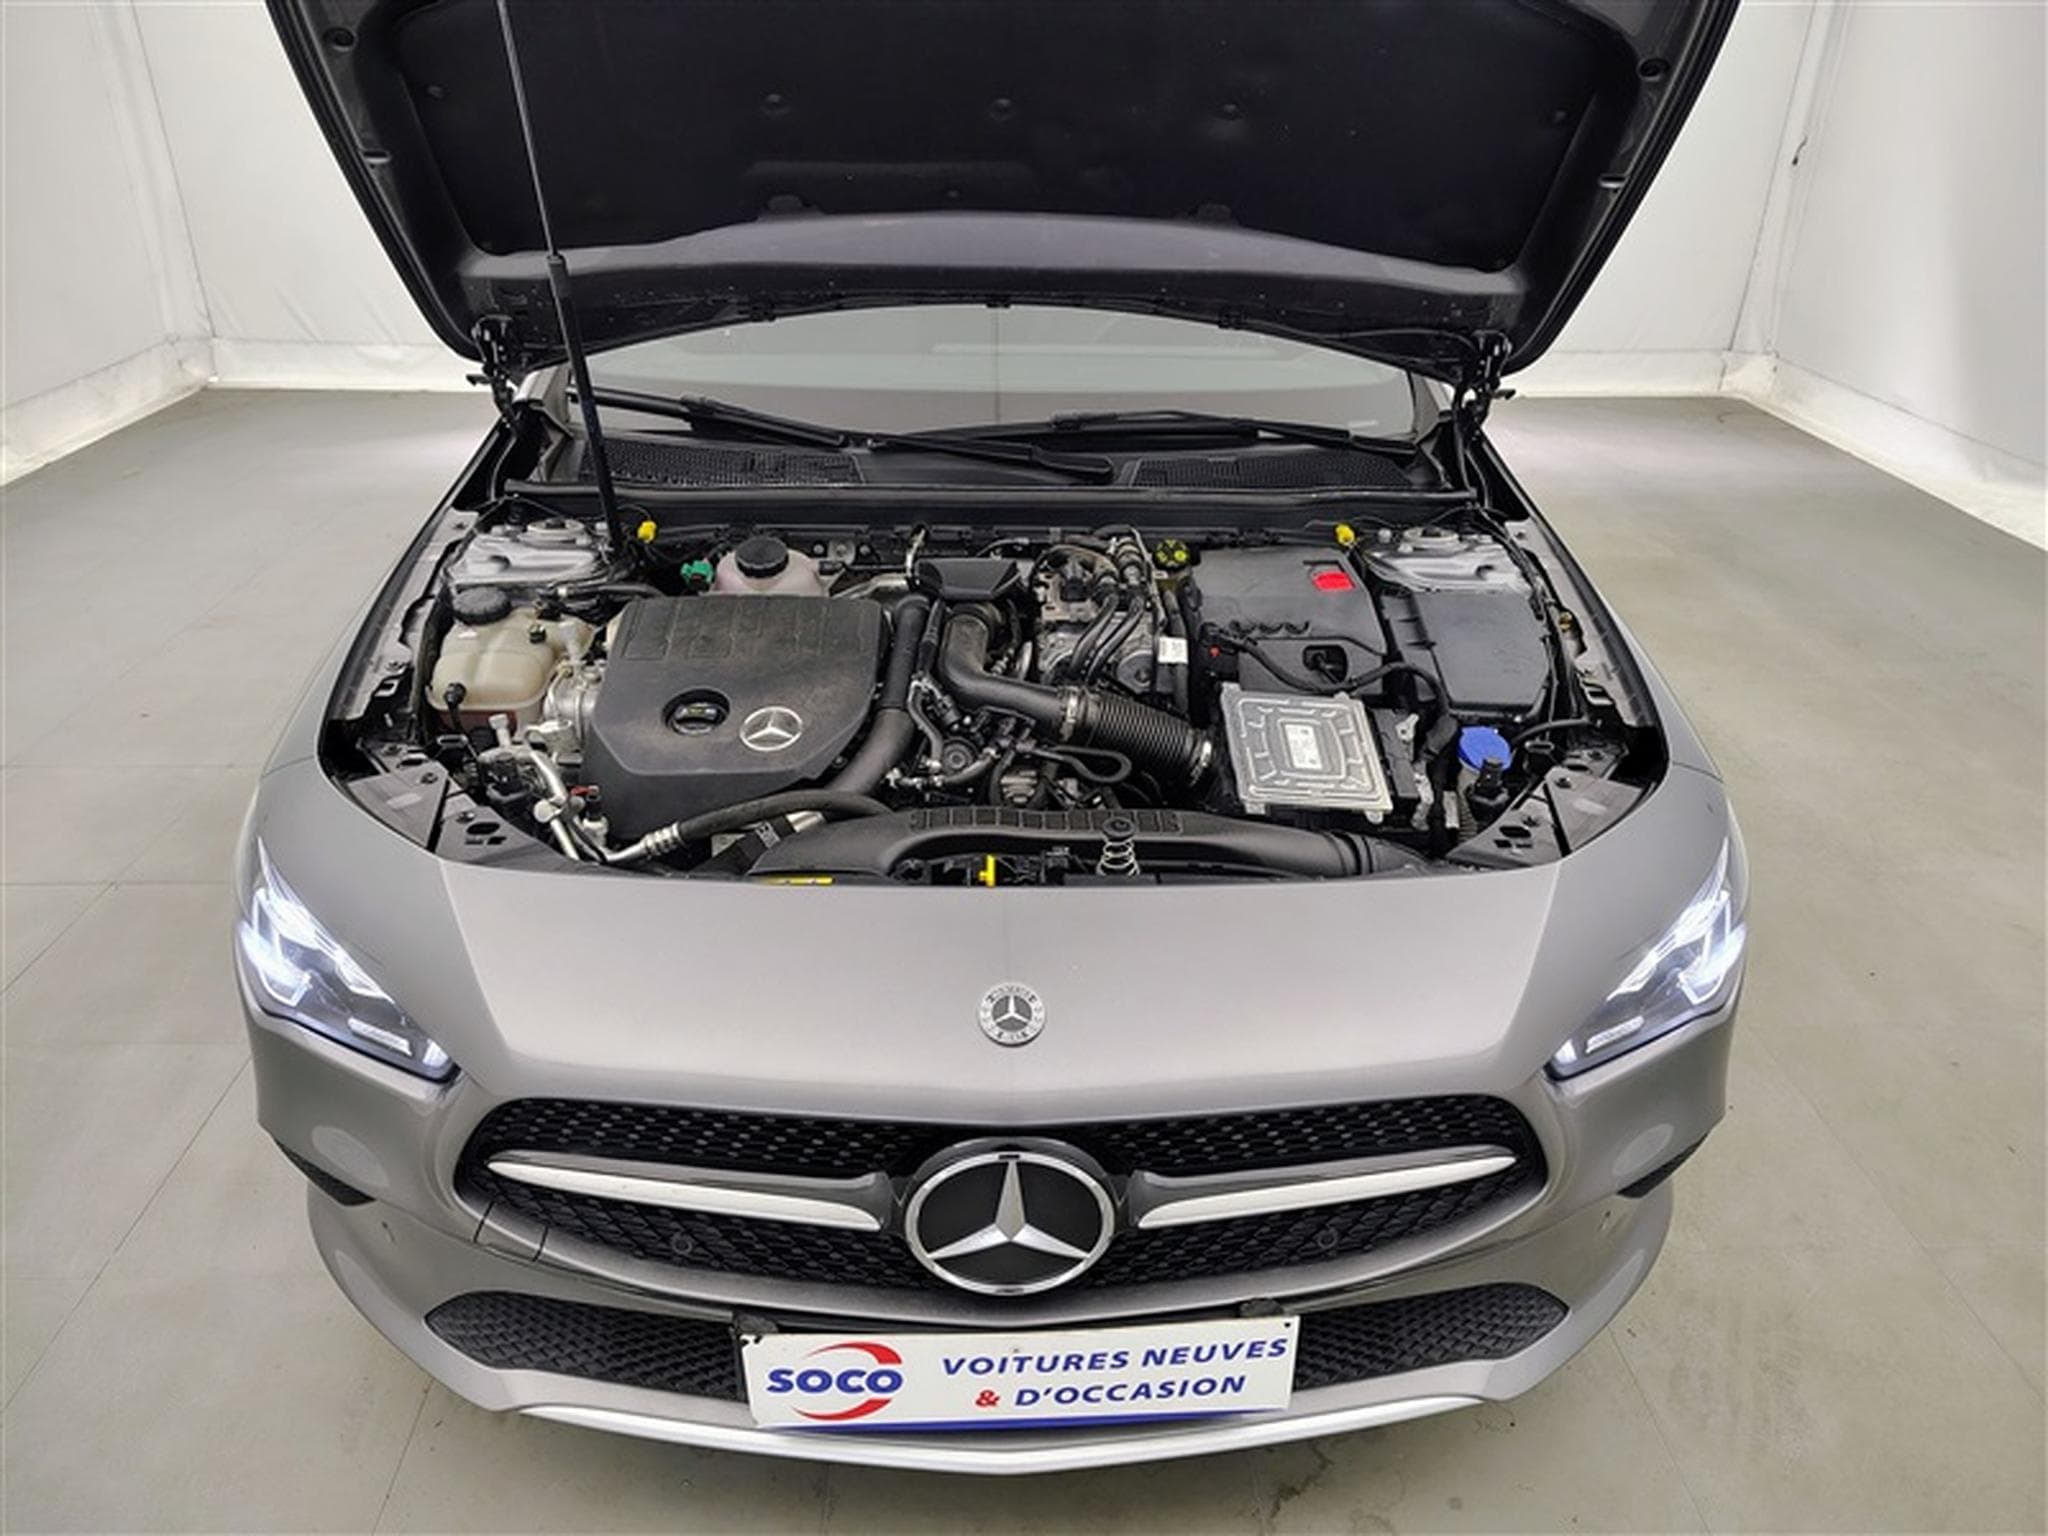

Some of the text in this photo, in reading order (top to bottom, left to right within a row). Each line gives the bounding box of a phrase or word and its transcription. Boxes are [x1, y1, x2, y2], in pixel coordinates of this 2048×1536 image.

[942, 1338, 1287, 1376] VOITURES NEUVES
[766, 1368, 903, 1395] SOCO
[975, 1375, 1247, 1408] & D'OCCASION
